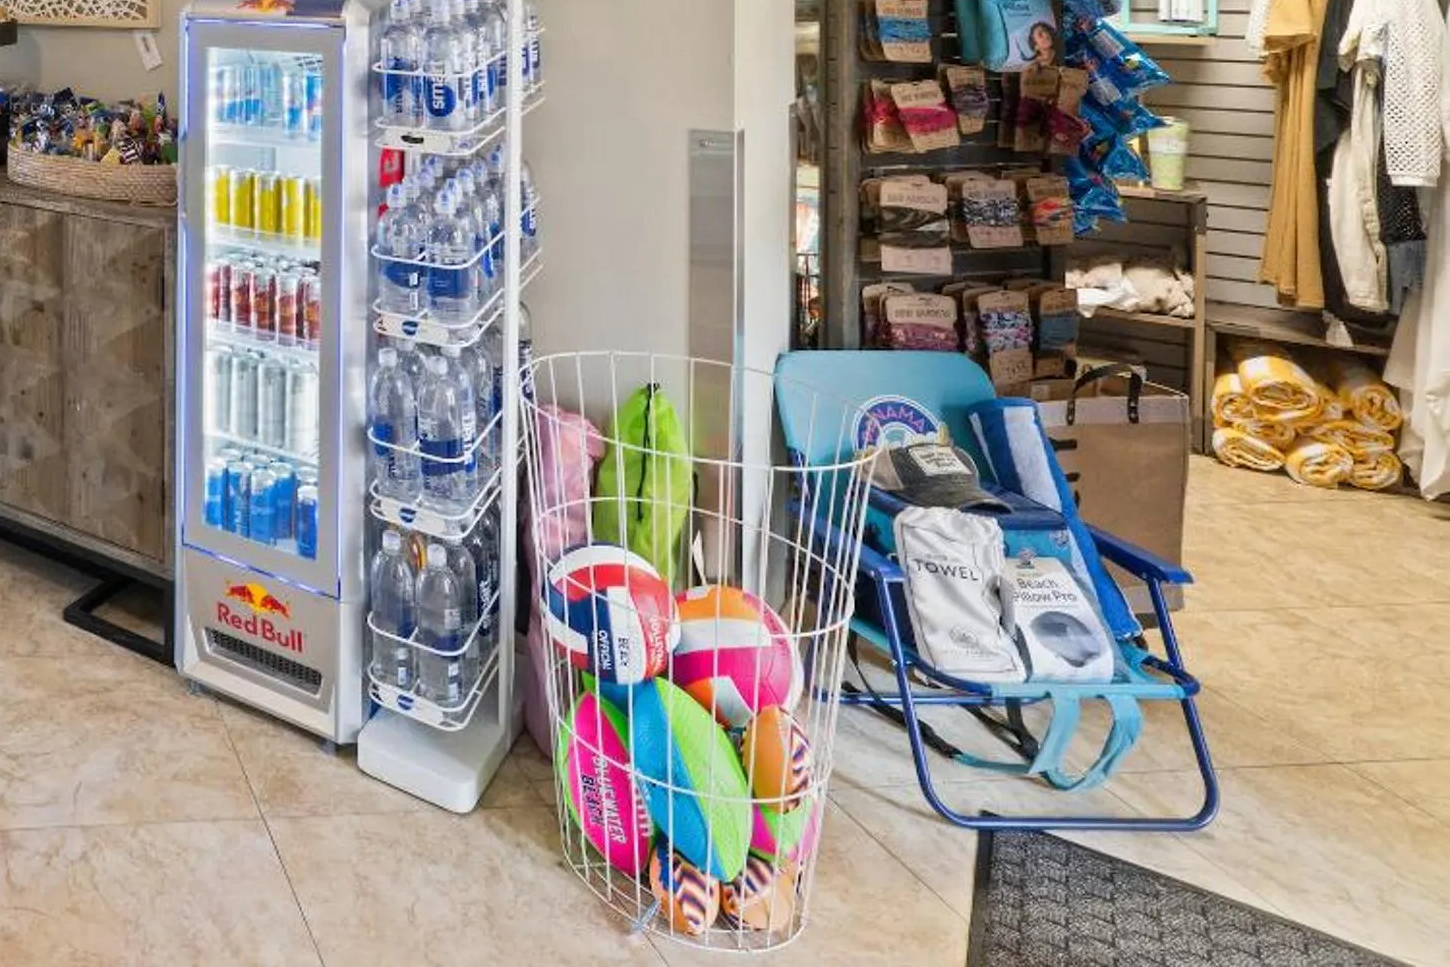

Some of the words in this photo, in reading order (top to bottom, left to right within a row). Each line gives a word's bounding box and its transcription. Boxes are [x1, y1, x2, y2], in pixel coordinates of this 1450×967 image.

[912, 558, 979, 582] TOWEL
[1016, 577, 1059, 589] Beach
[217, 602, 257, 634] Red
[261, 619, 302, 652] Bull
